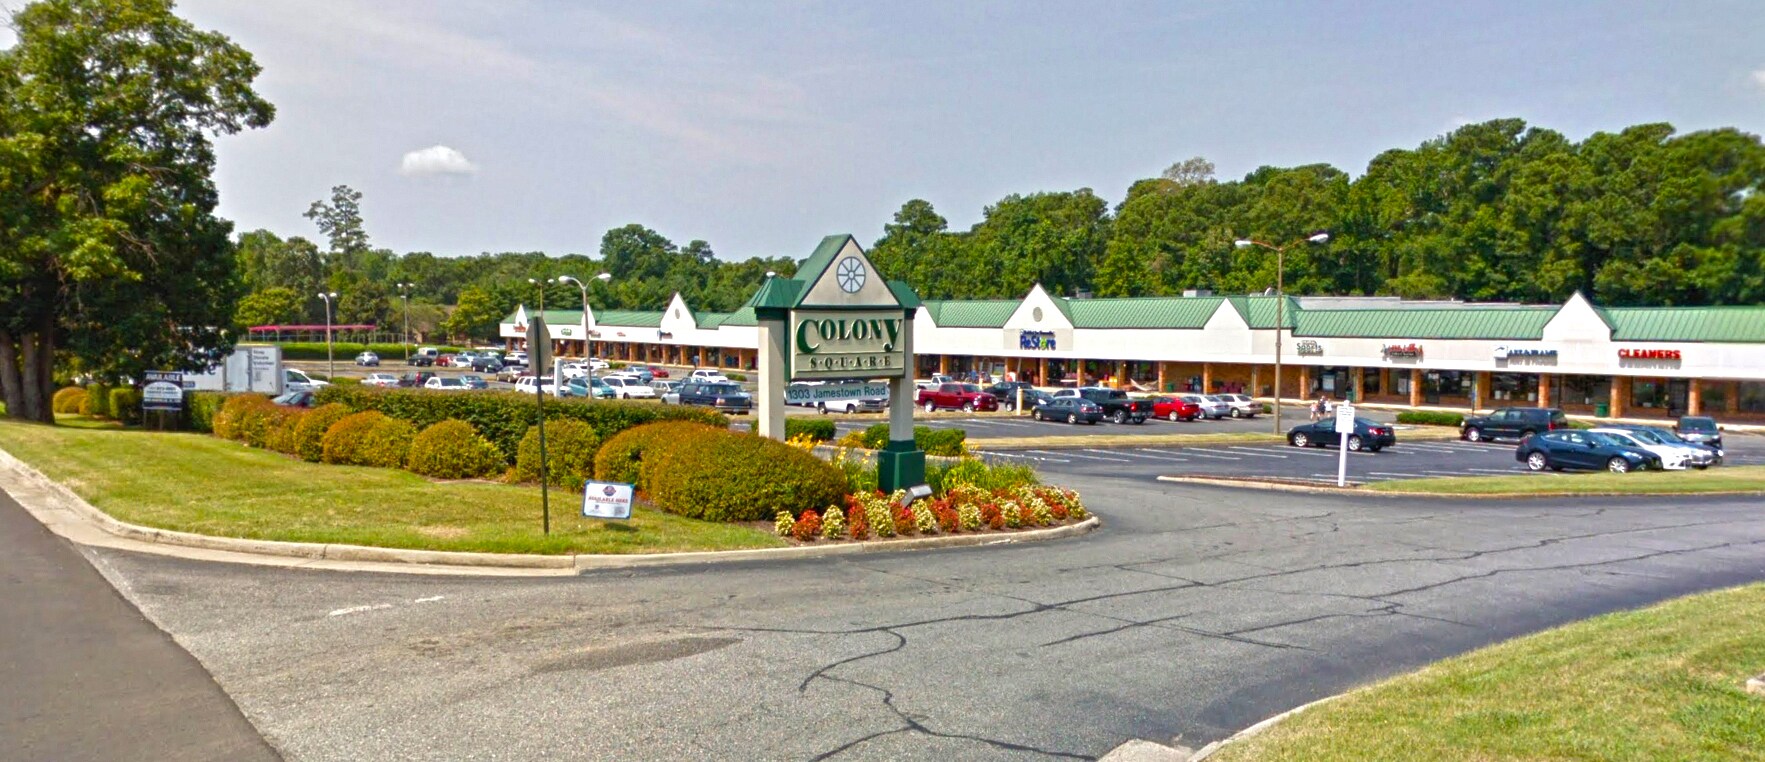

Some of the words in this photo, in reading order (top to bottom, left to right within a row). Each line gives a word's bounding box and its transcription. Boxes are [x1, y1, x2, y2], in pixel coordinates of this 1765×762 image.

[1020, 334, 1056, 350] ReStore
[1617, 348, 1681, 359] CLEANERS
[788, 388, 811, 400] 1303
[813, 387, 861, 399] Jamestown
[864, 385, 886, 396] Road
